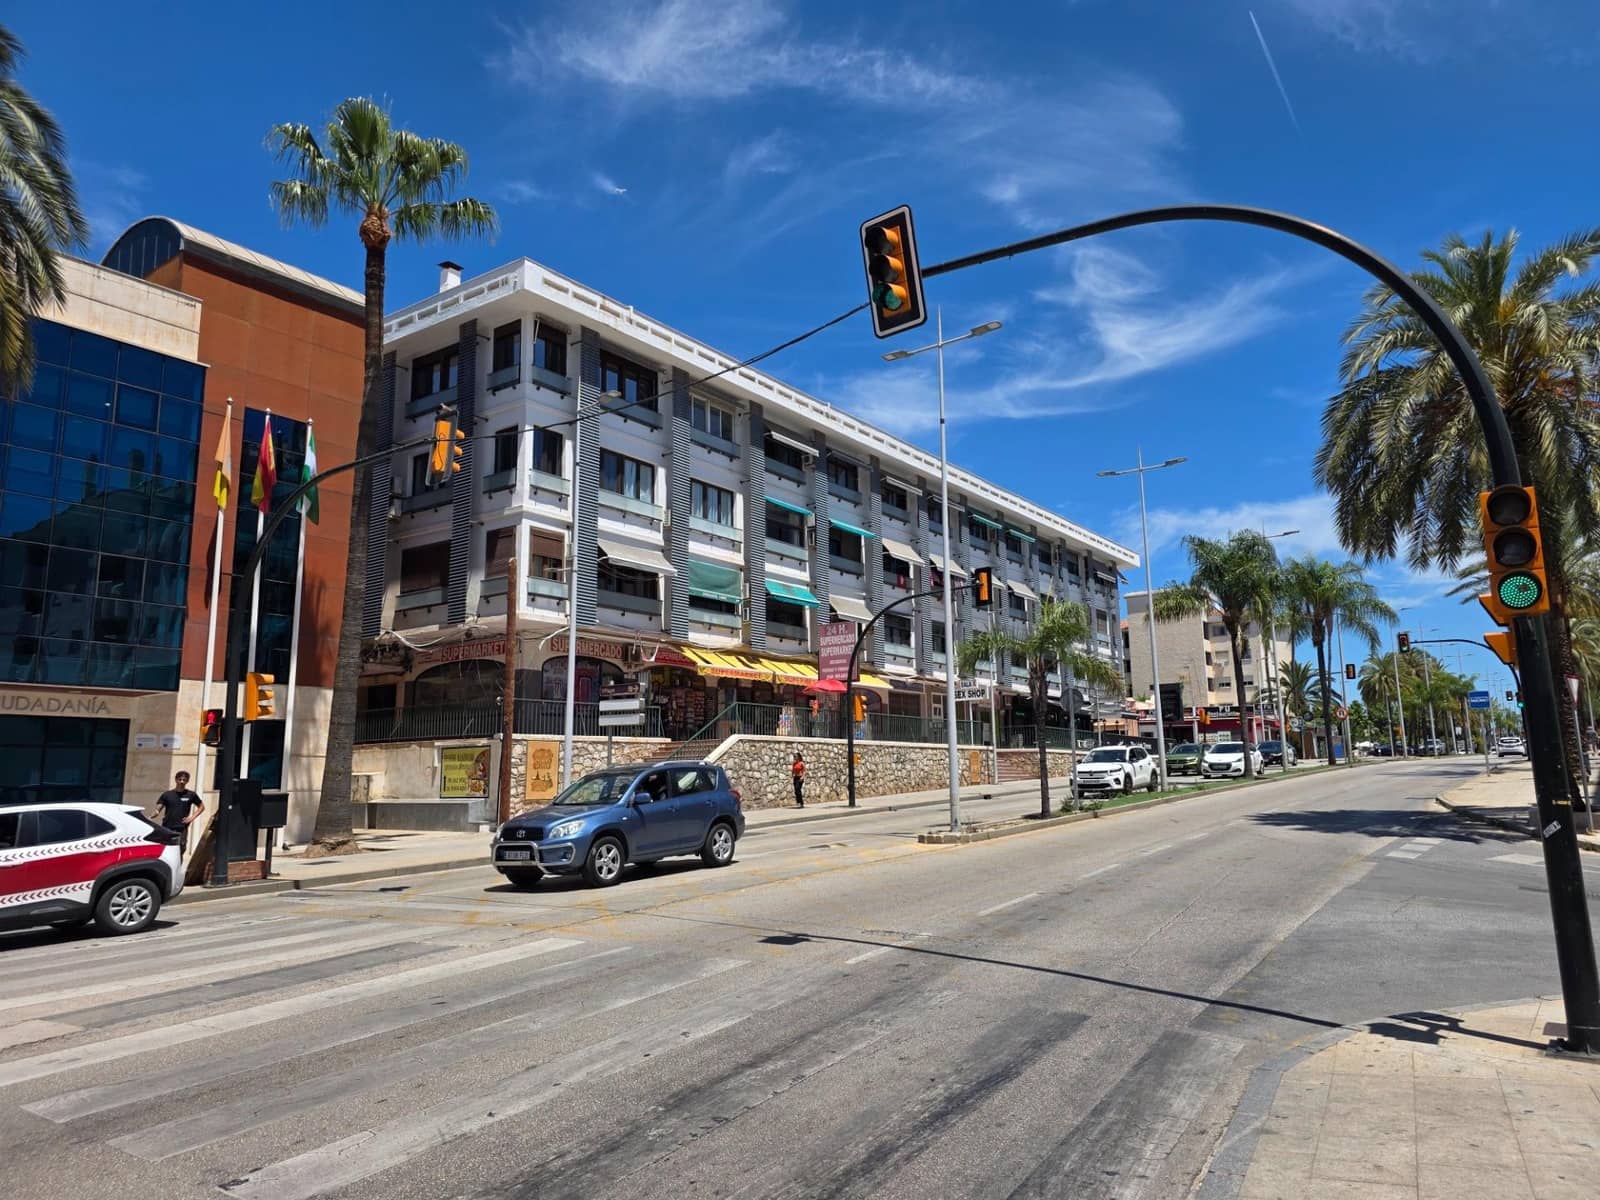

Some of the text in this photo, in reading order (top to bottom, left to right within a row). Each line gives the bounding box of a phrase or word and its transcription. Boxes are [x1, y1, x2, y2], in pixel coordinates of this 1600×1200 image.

[826, 624, 837, 635] 24
[440, 640, 505, 661] SUPERMARKET
[552, 637, 622, 658] SUPRMERCADO
[967, 689, 986, 698] SHOP
[0, 695, 112, 713] UDADANÍA
